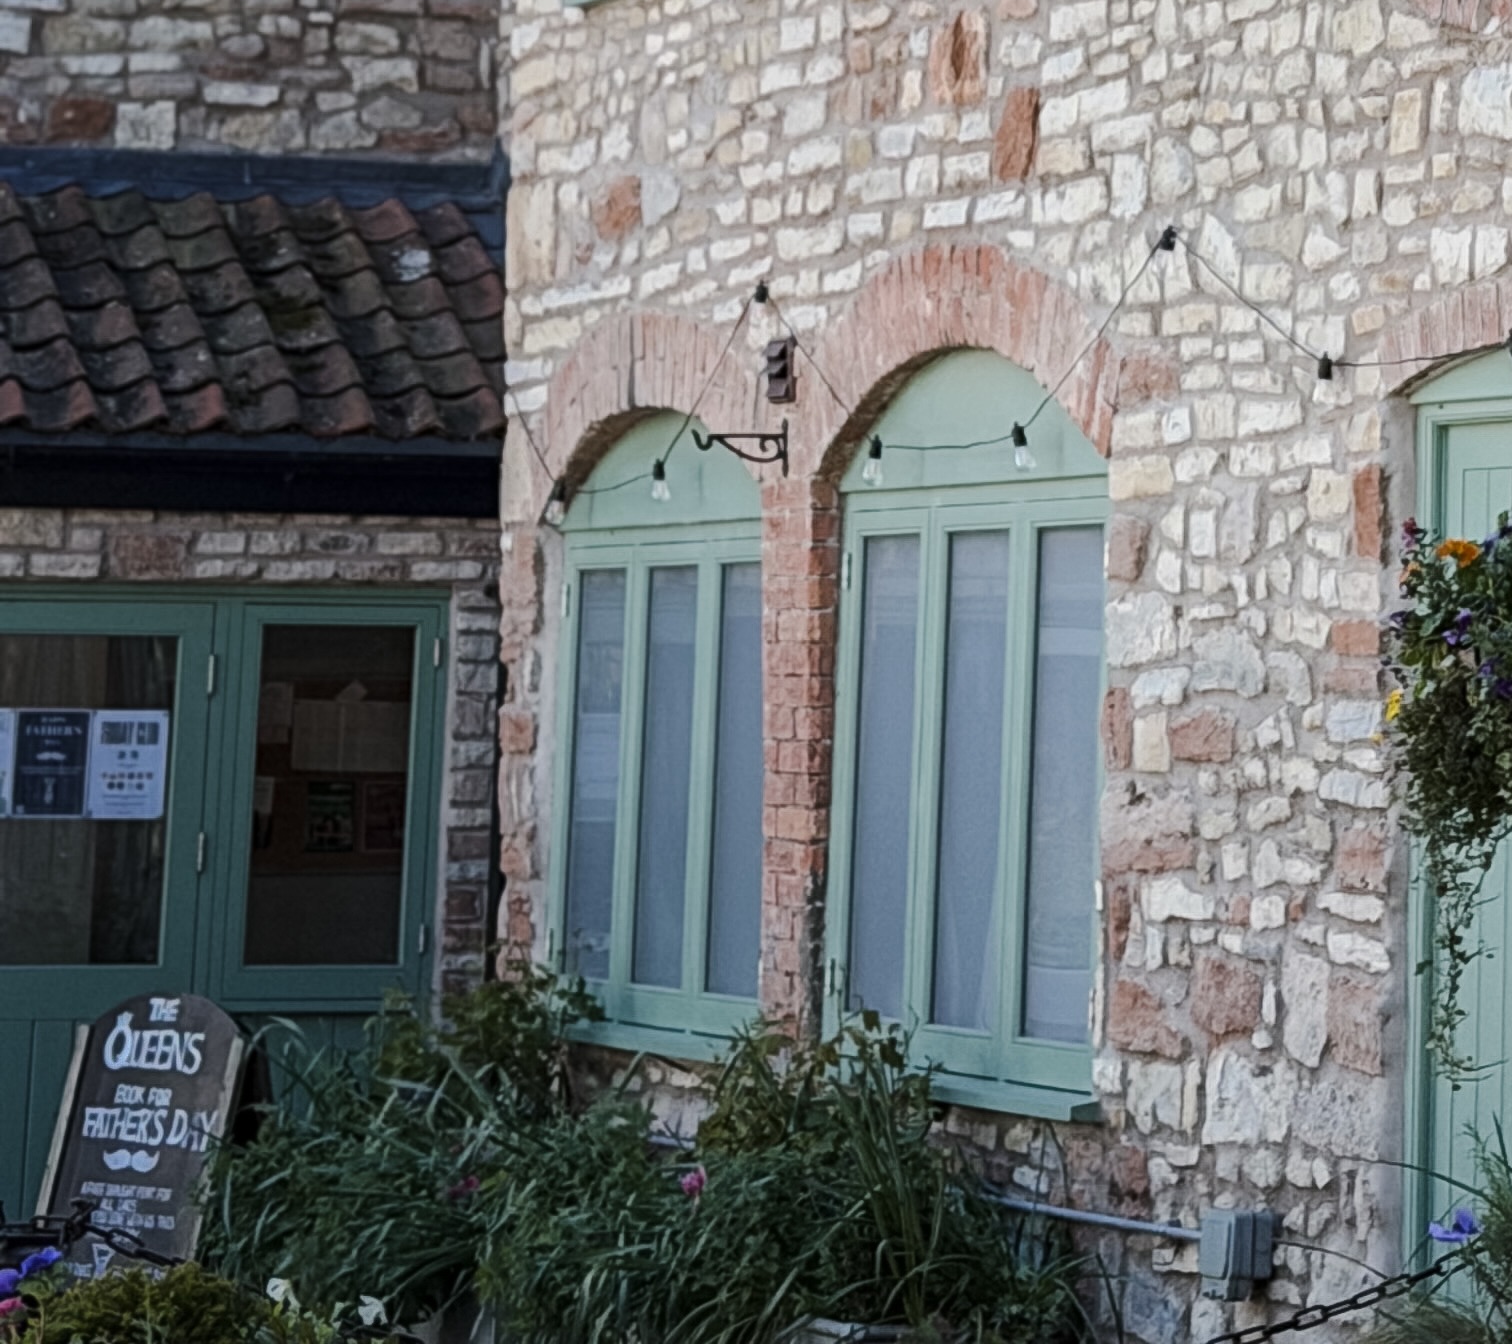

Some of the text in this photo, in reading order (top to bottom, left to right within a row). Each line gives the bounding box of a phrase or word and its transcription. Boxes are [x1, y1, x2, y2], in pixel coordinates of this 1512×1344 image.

[149, 997, 181, 1022] THE
[104, 1024, 206, 1075] QUEENS
[114, 1083, 173, 1107] BOOK FOR
